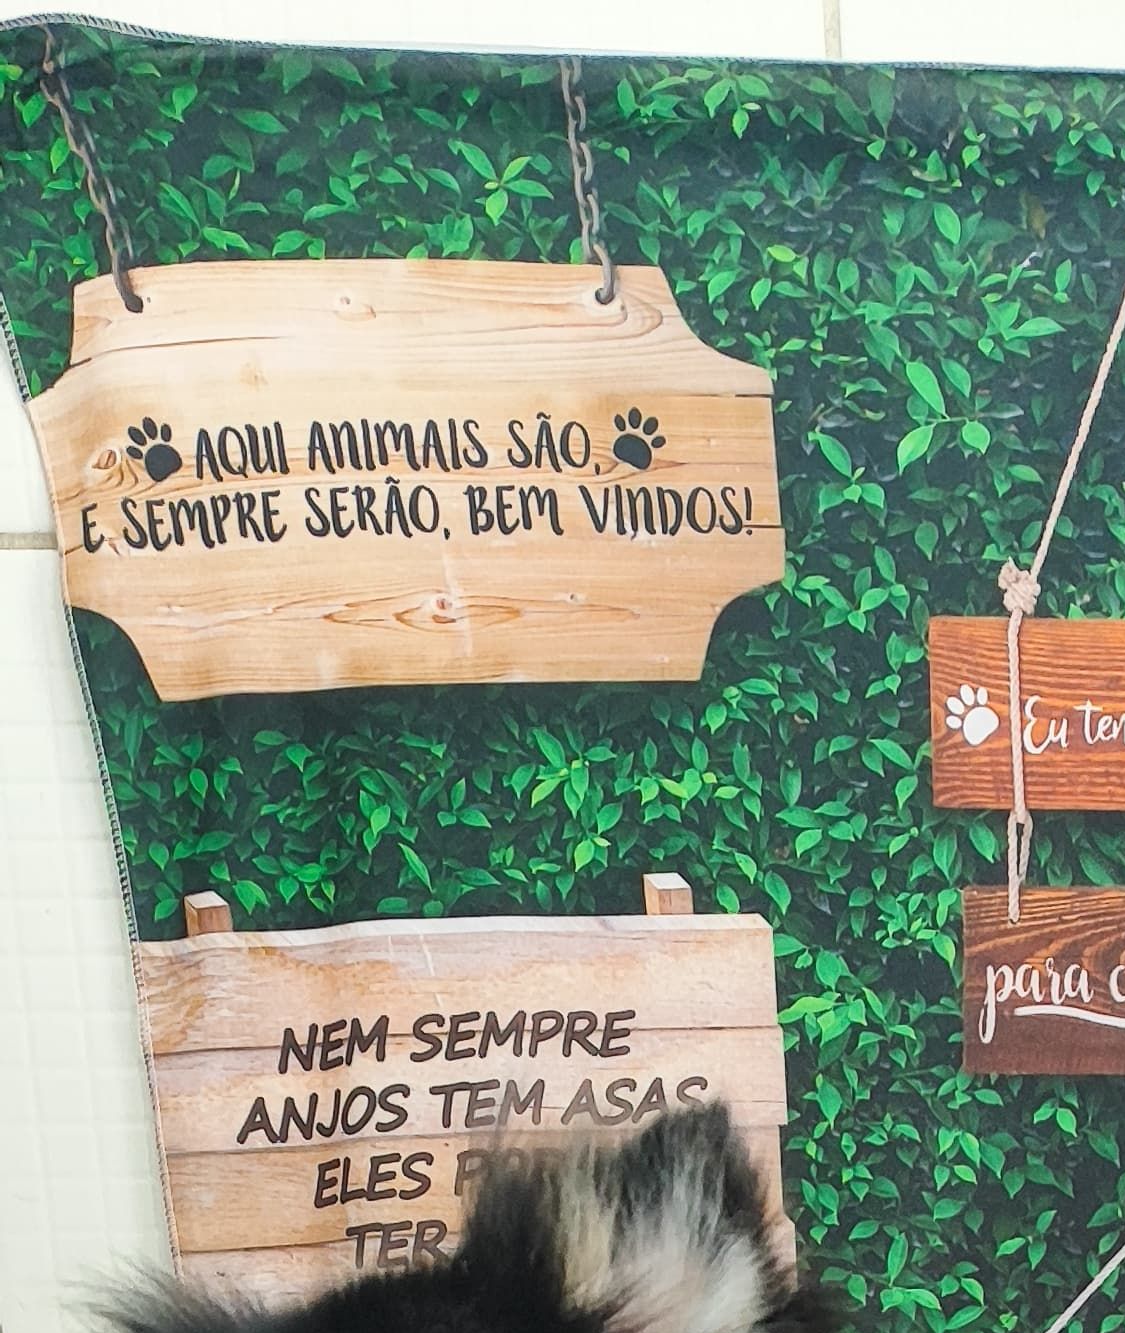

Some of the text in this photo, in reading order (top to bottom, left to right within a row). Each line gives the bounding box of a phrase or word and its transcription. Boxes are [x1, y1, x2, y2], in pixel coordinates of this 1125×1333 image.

[196, 412, 601, 482] AQUI ANIMAIS SÃO,
[81, 476, 753, 553] E SEMPRE SERÃO, BEM VINDOS!
[1022, 694, 1069, 755] Eu
[978, 957, 1094, 1044] para
[278, 1009, 636, 1074] NEM SEMPRE
[237, 1084, 410, 1144] ANJOS
[429, 1079, 546, 1128] TEM
[314, 1152, 434, 1208] ELES
